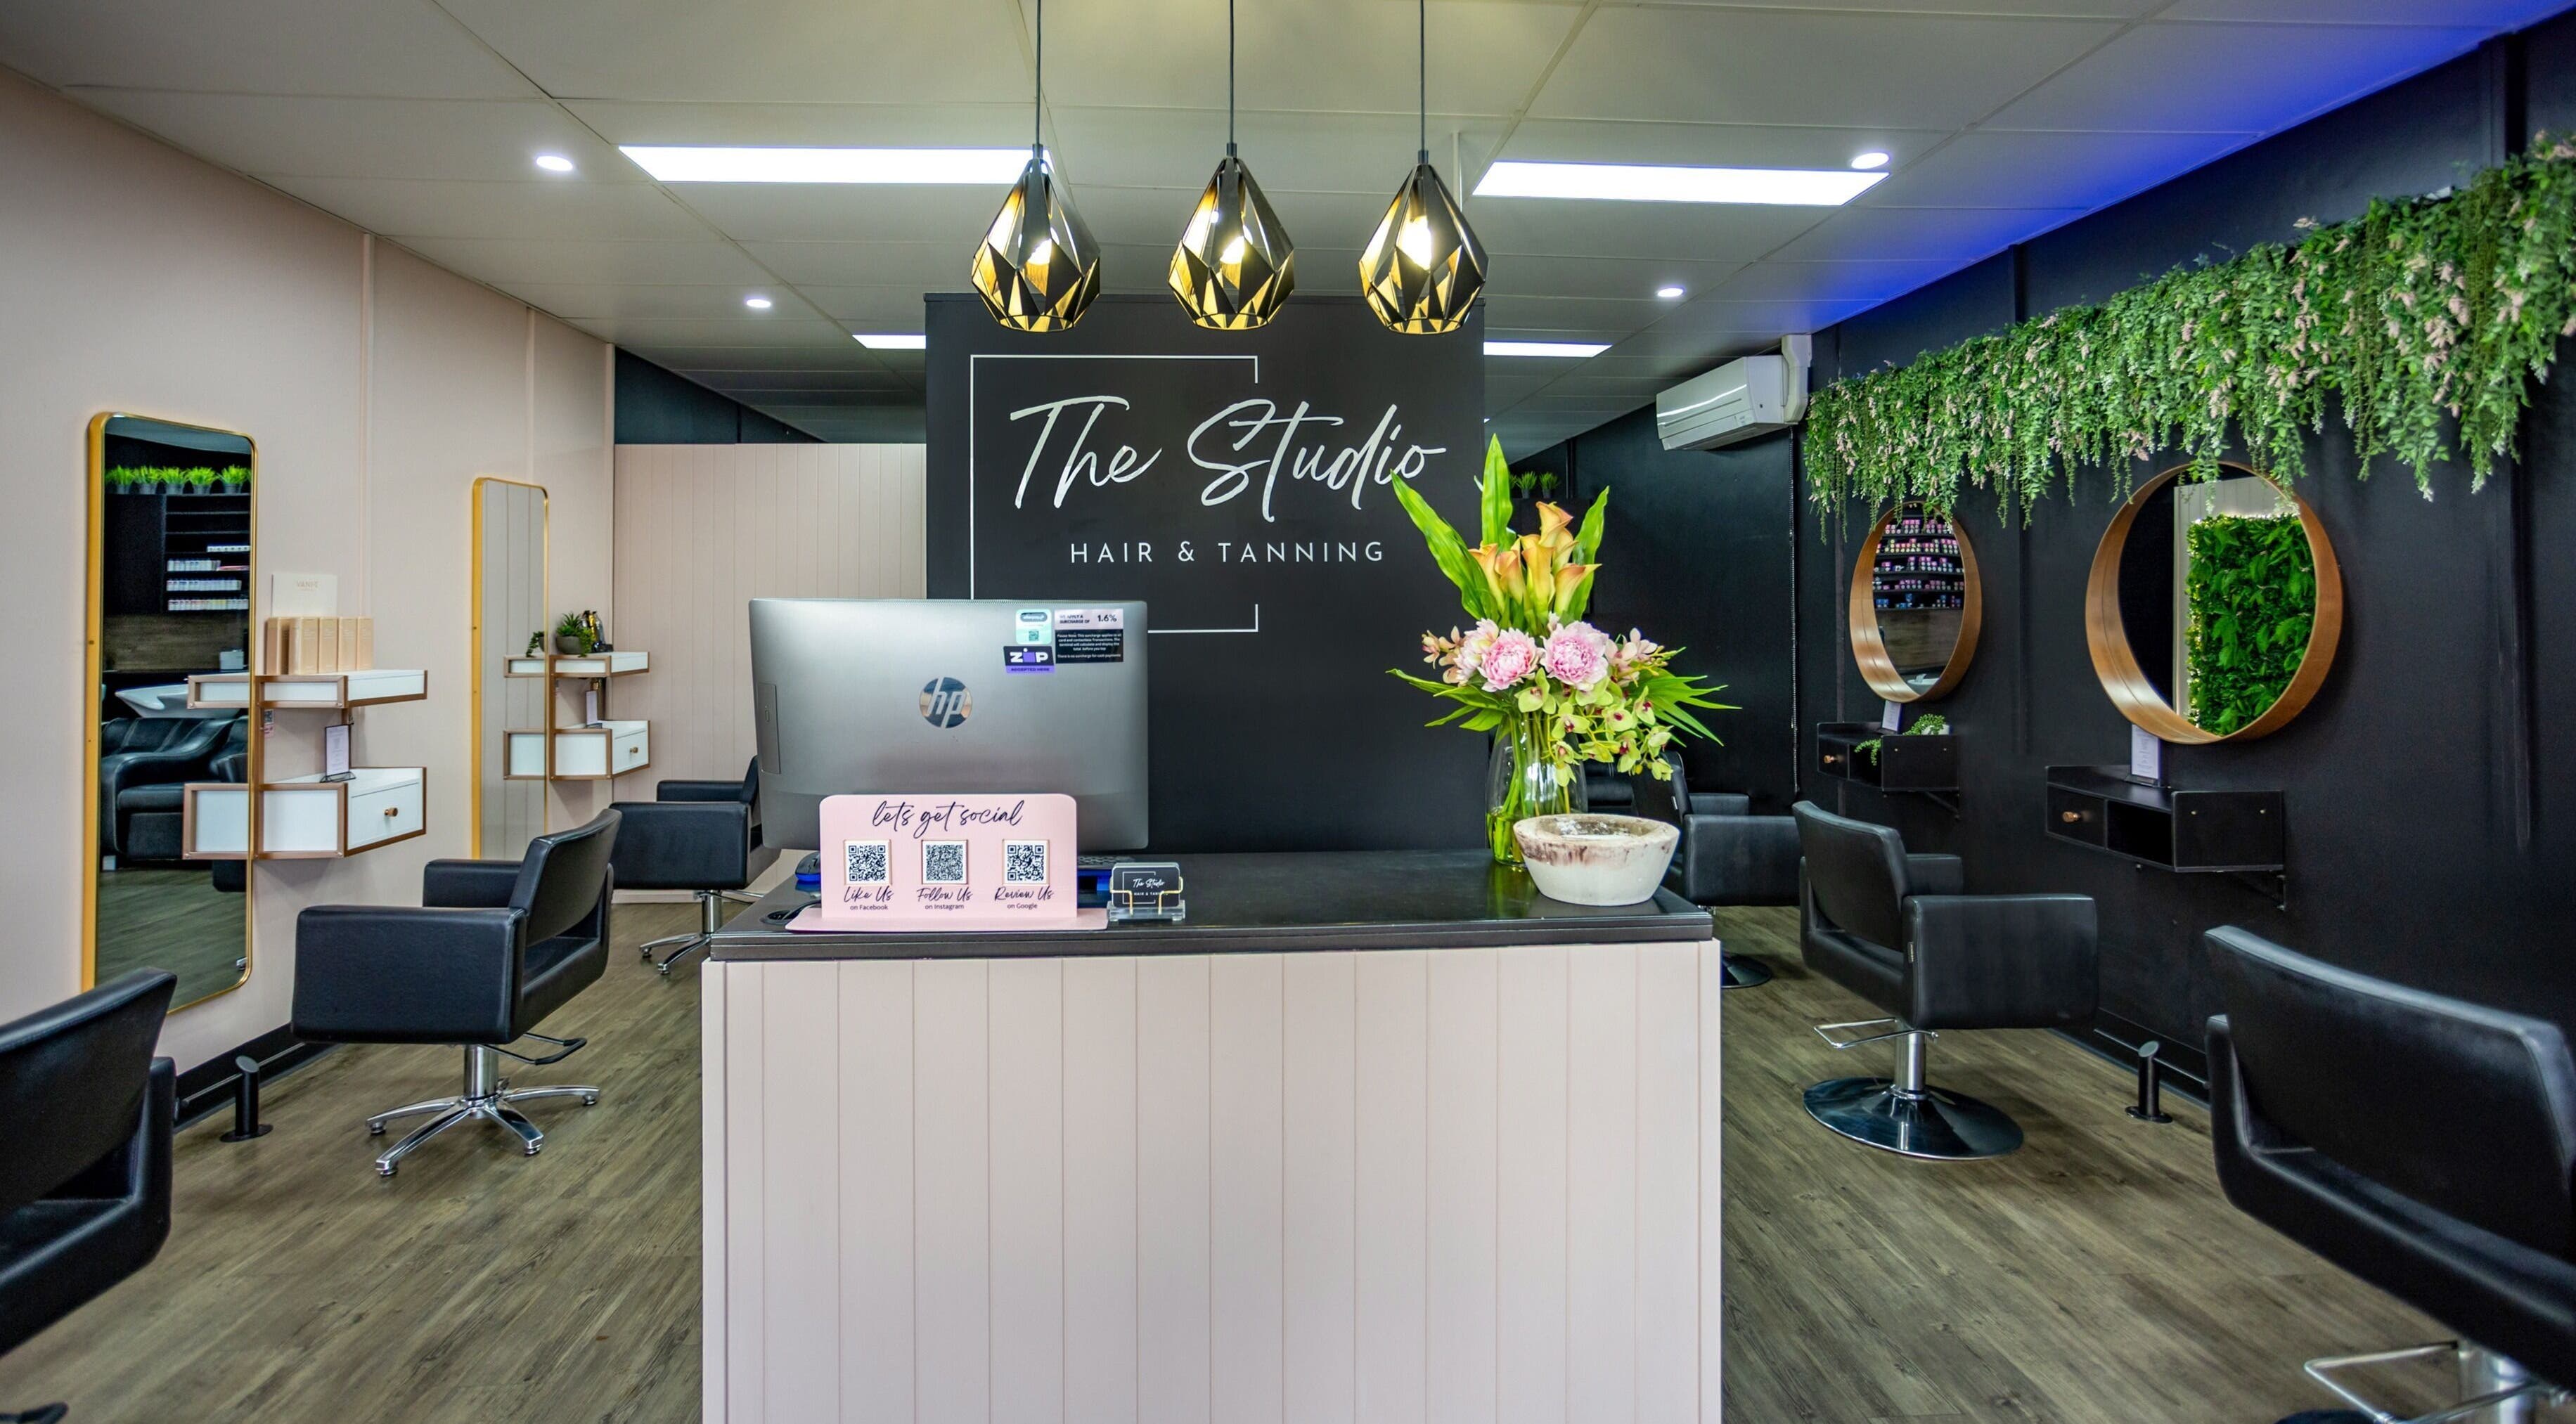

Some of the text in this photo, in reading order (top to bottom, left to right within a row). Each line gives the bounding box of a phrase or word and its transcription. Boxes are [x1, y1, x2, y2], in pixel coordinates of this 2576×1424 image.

[1010, 395, 1447, 523] The Studio
[1071, 541, 1383, 563] HAIR & TANNING
[925, 677, 969, 729] hp
[872, 800, 1025, 839] lets get social
[1133, 878, 1145, 888] The
[844, 886, 894, 902] Like Us
[916, 887, 973, 902] Follow Us
[994, 886, 1054, 901] Review Us
